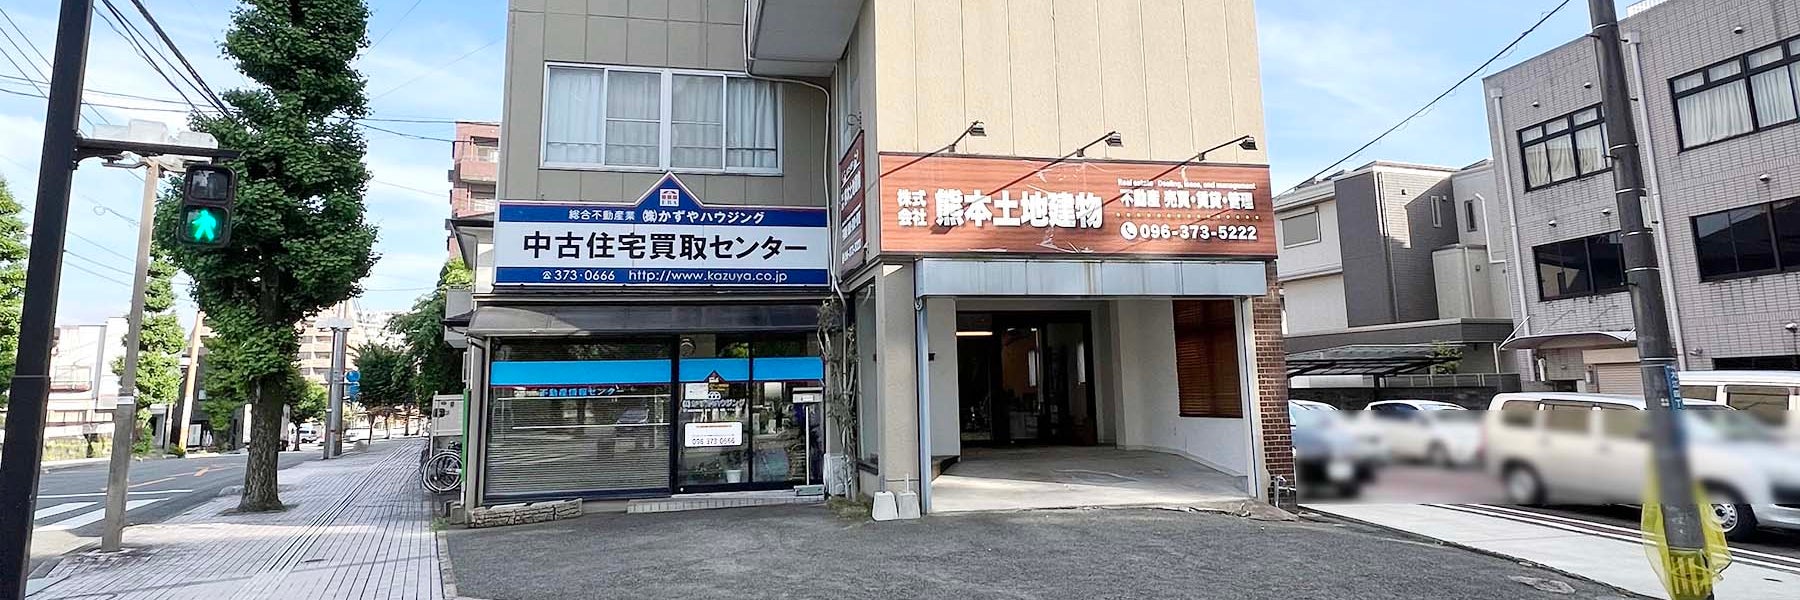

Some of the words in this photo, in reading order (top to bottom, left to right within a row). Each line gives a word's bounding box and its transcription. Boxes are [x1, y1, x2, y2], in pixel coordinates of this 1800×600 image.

[896, 189, 927, 207] 株式
[1120, 189, 1161, 208] 不動産
[568, 208, 635, 222] 総合不動産業
[897, 208, 927, 226] 会社
[935, 189, 1104, 229] 熊本土地建物
[1140, 224, 1257, 240] 096-373-5222
[523, 230, 808, 261] 中古住宅買取センター
[628, 269, 788, 283] http://www.kazuya.co.jp
